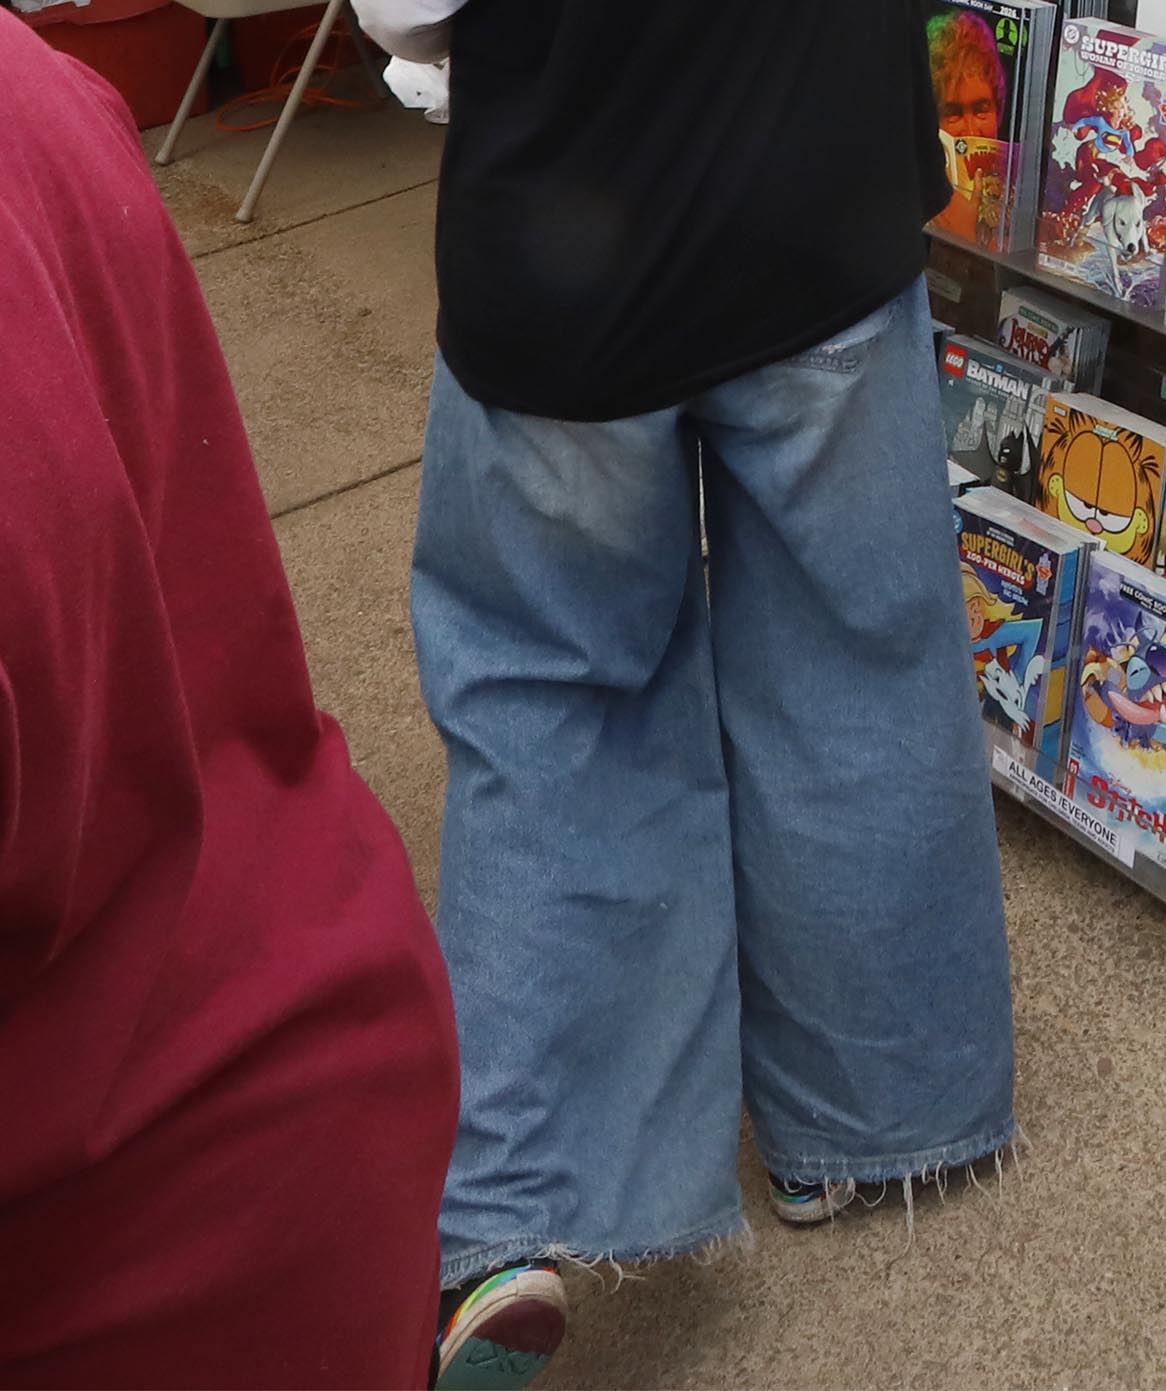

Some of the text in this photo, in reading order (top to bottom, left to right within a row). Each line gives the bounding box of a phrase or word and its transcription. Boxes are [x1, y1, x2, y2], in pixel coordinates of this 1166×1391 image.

[966, 360, 1030, 400] BATMAN
[961, 531, 1035, 581] SUPERGIRL'S
[1120, 583, 1134, 596] FREE
[1134, 589, 1153, 605] COMIC
[1008, 761, 1118, 846] ALL AGES /EVERYONE
